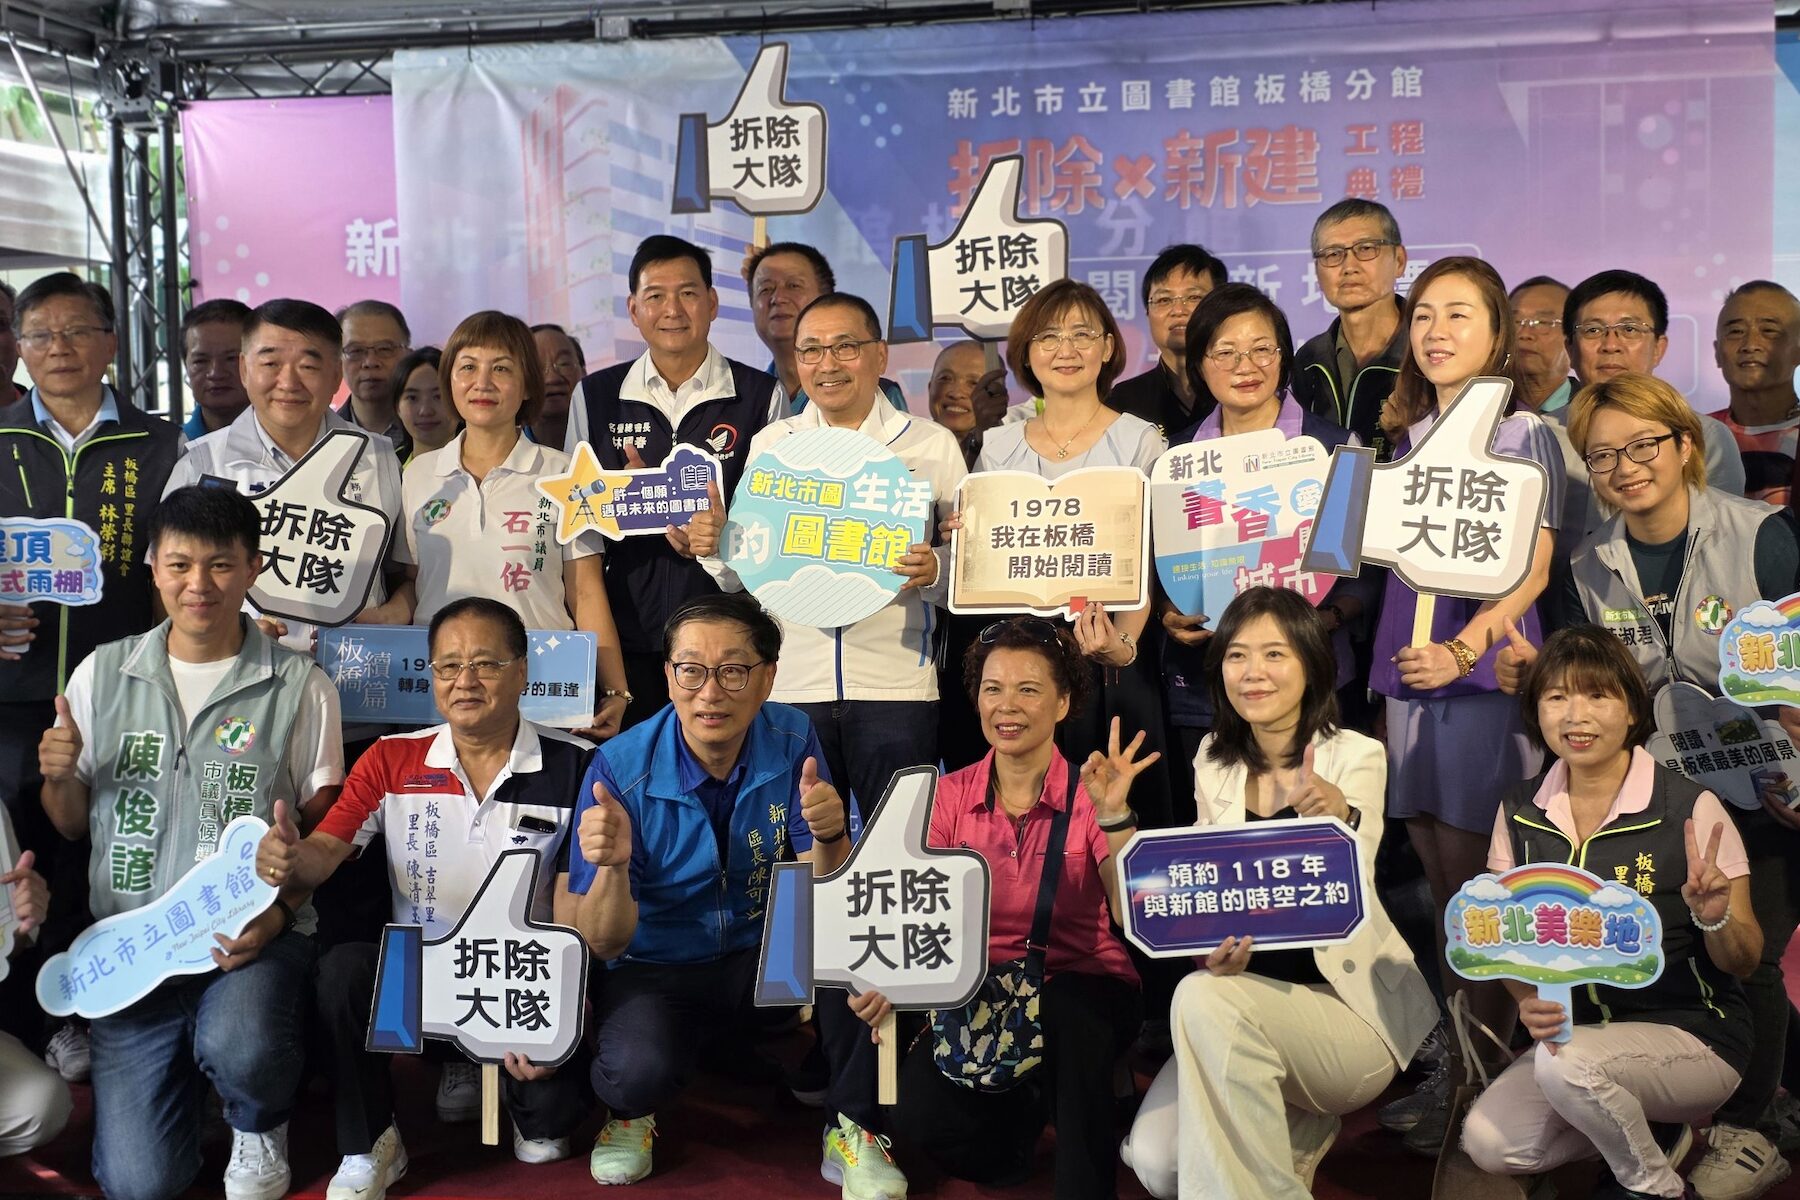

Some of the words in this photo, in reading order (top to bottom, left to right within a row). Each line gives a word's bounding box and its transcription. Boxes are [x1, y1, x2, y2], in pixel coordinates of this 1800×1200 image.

[948, 66, 1424, 119] 新北市立圖書館板橋分館
[730, 114, 801, 151] 拆除
[1344, 121, 1425, 156] 工程
[732, 154, 803, 190] 大隊
[1344, 166, 1425, 200] 典禮
[955, 232, 1039, 275] 拆除
[959, 273, 1042, 315] 大隊
[100, 462, 117, 495] 主席
[1169, 450, 1223, 481] 新北
[1404, 464, 1509, 512] 拆除
[601, 497, 710, 518] 遇見未來的圖書館
[750, 471, 844, 509] 新北市圖
[853, 473, 932, 519] 生活
[1009, 498, 1081, 518] 1978
[1182, 479, 1280, 544] 書香
[259, 499, 356, 552] 拆除
[532, 496, 553, 573] 新北市議員
[728, 520, 768, 567] 的
[783, 516, 907, 569] 圖書館
[991, 523, 1095, 550] 我在板橋
[1400, 515, 1503, 562] 大隊
[259, 546, 345, 595] 大隊
[500, 511, 533, 593] 石一佑
[1008, 553, 1113, 580] 開始閱讀
[0, 569, 83, 594] 式雨棚
[335, 636, 363, 693] 板橋
[361, 651, 391, 709] 續篇
[398, 678, 430, 695] 轉身
[111, 730, 166, 894] 陳俊諺
[223, 762, 258, 823] 板橋
[406, 813, 419, 851] 里長
[425, 801, 440, 858] 板橋區
[748, 829, 767, 866] 區長
[847, 867, 951, 919] 拆除
[1168, 863, 1217, 888] 預約
[1233, 859, 1289, 878] 118
[1302, 854, 1327, 876] 年
[1634, 852, 1656, 899] 板橋
[425, 866, 437, 923] 吉翠里
[1143, 881, 1349, 918] 與新館的時空之約
[59, 866, 255, 1001] 新北市立圖書館
[848, 921, 953, 972] 大隊
[1463, 903, 1642, 955] 新北美樂地
[453, 938, 551, 982] 拆除
[454, 987, 552, 1032] 大隊
